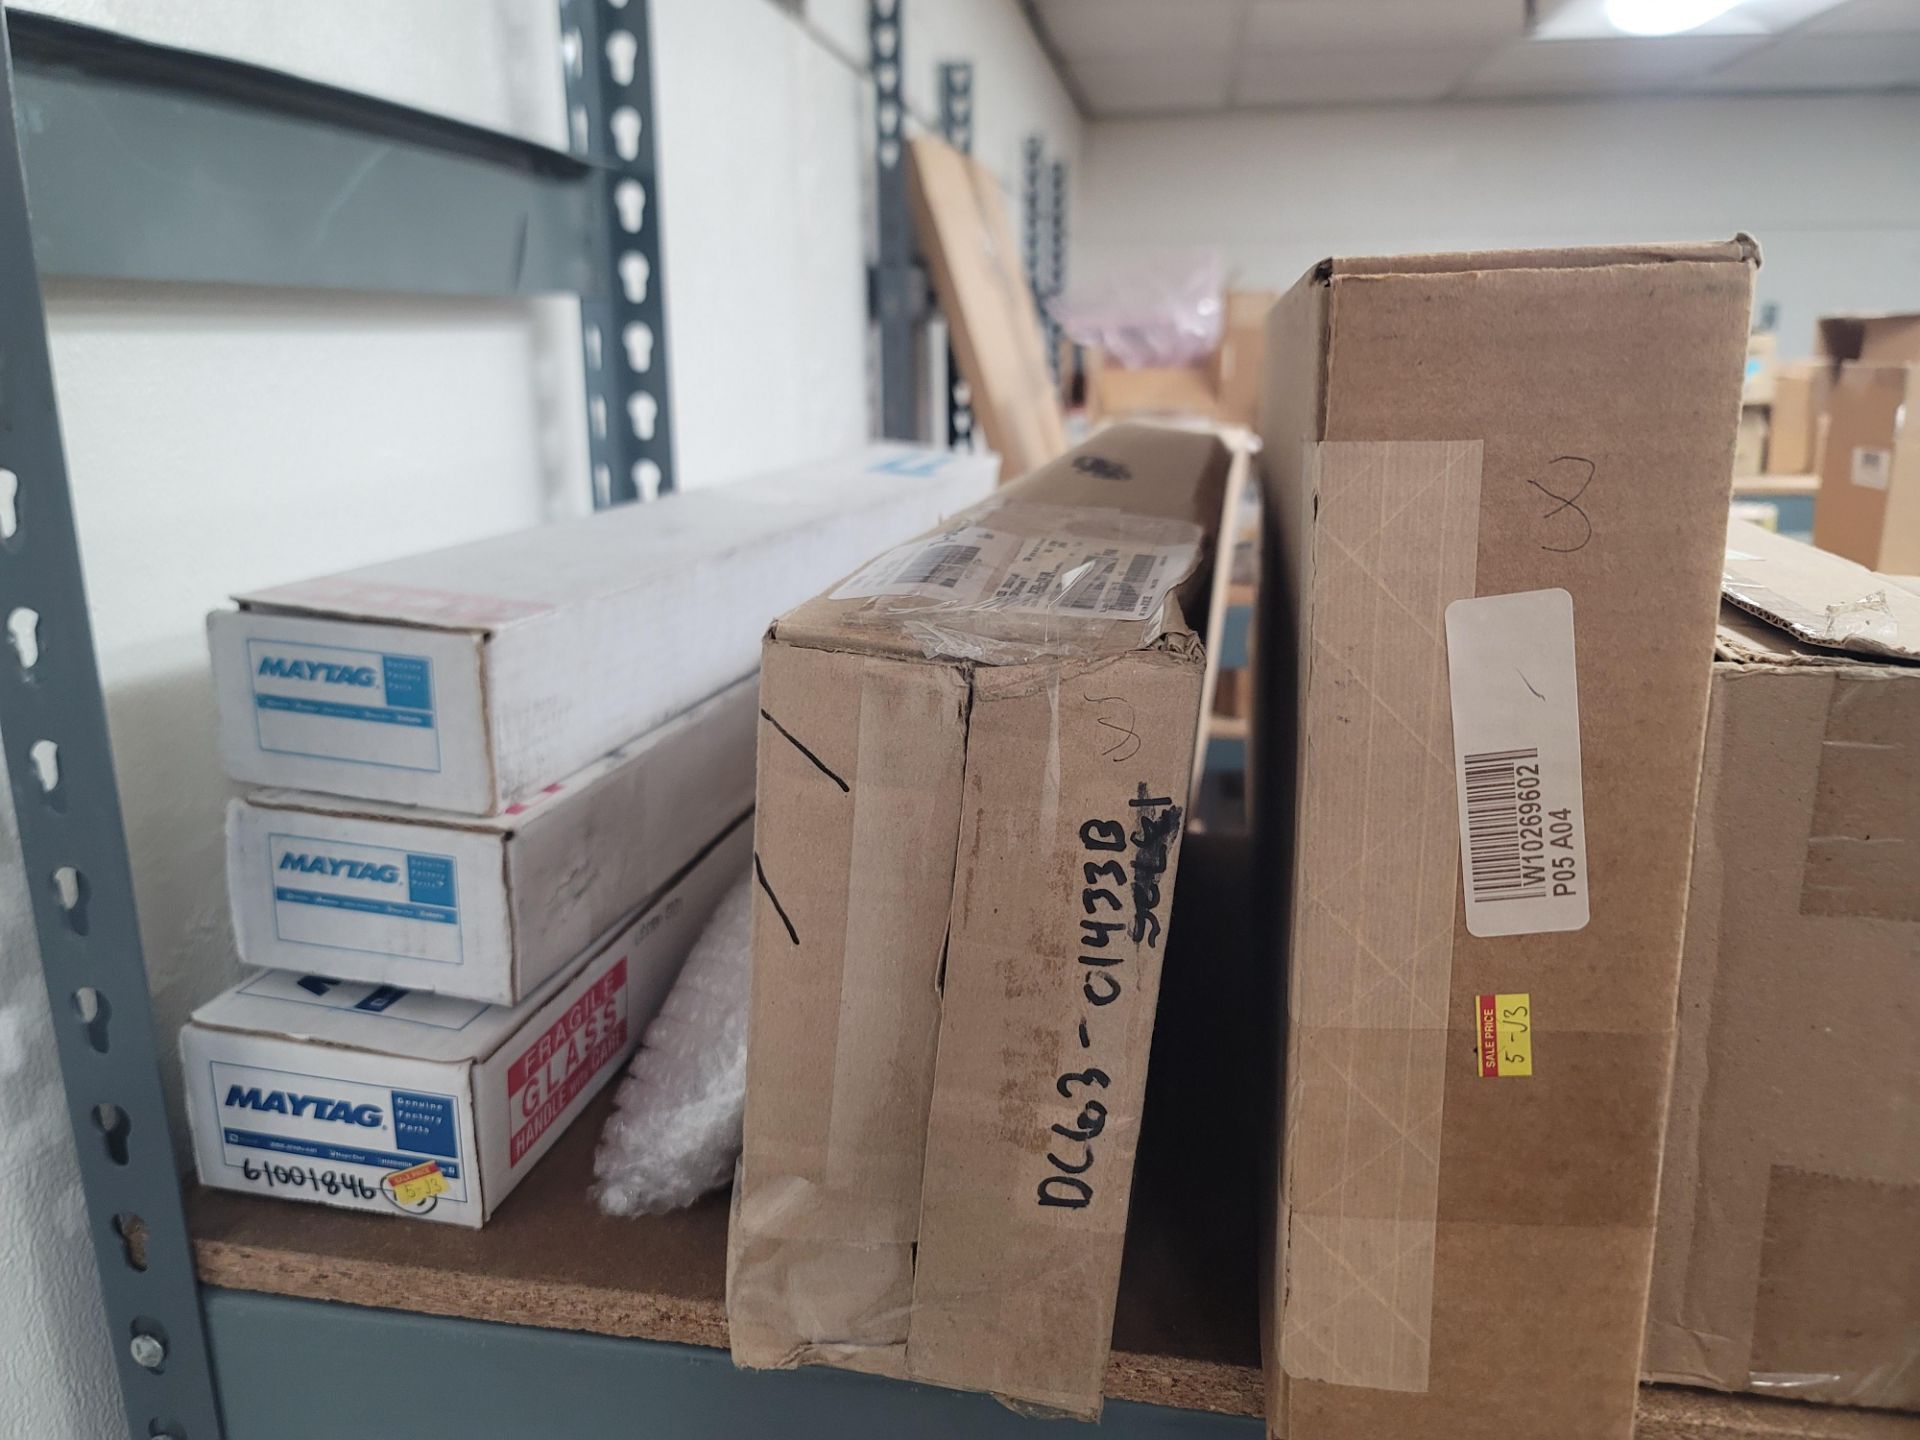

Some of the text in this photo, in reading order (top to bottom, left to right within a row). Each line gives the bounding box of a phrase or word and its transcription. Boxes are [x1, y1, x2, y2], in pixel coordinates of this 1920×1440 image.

[258, 655, 377, 687] MAYTAG
[1515, 764, 1546, 887] W10269602
[279, 851, 400, 884] MAYTAG
[1548, 807, 1577, 897] P05 A04
[523, 970, 616, 1078] FRAGILE
[1483, 1008, 1496, 1068] SALE PRICE
[521, 997, 618, 1118] GLASS
[224, 1084, 384, 1128] MAYTAG
[396, 1096, 444, 1111] Genuine
[398, 1109, 443, 1124] Factory
[515, 1089, 567, 1156] HANDLE
[399, 1122, 430, 1134] Parts
[243, 1158, 377, 1199] 61001846
